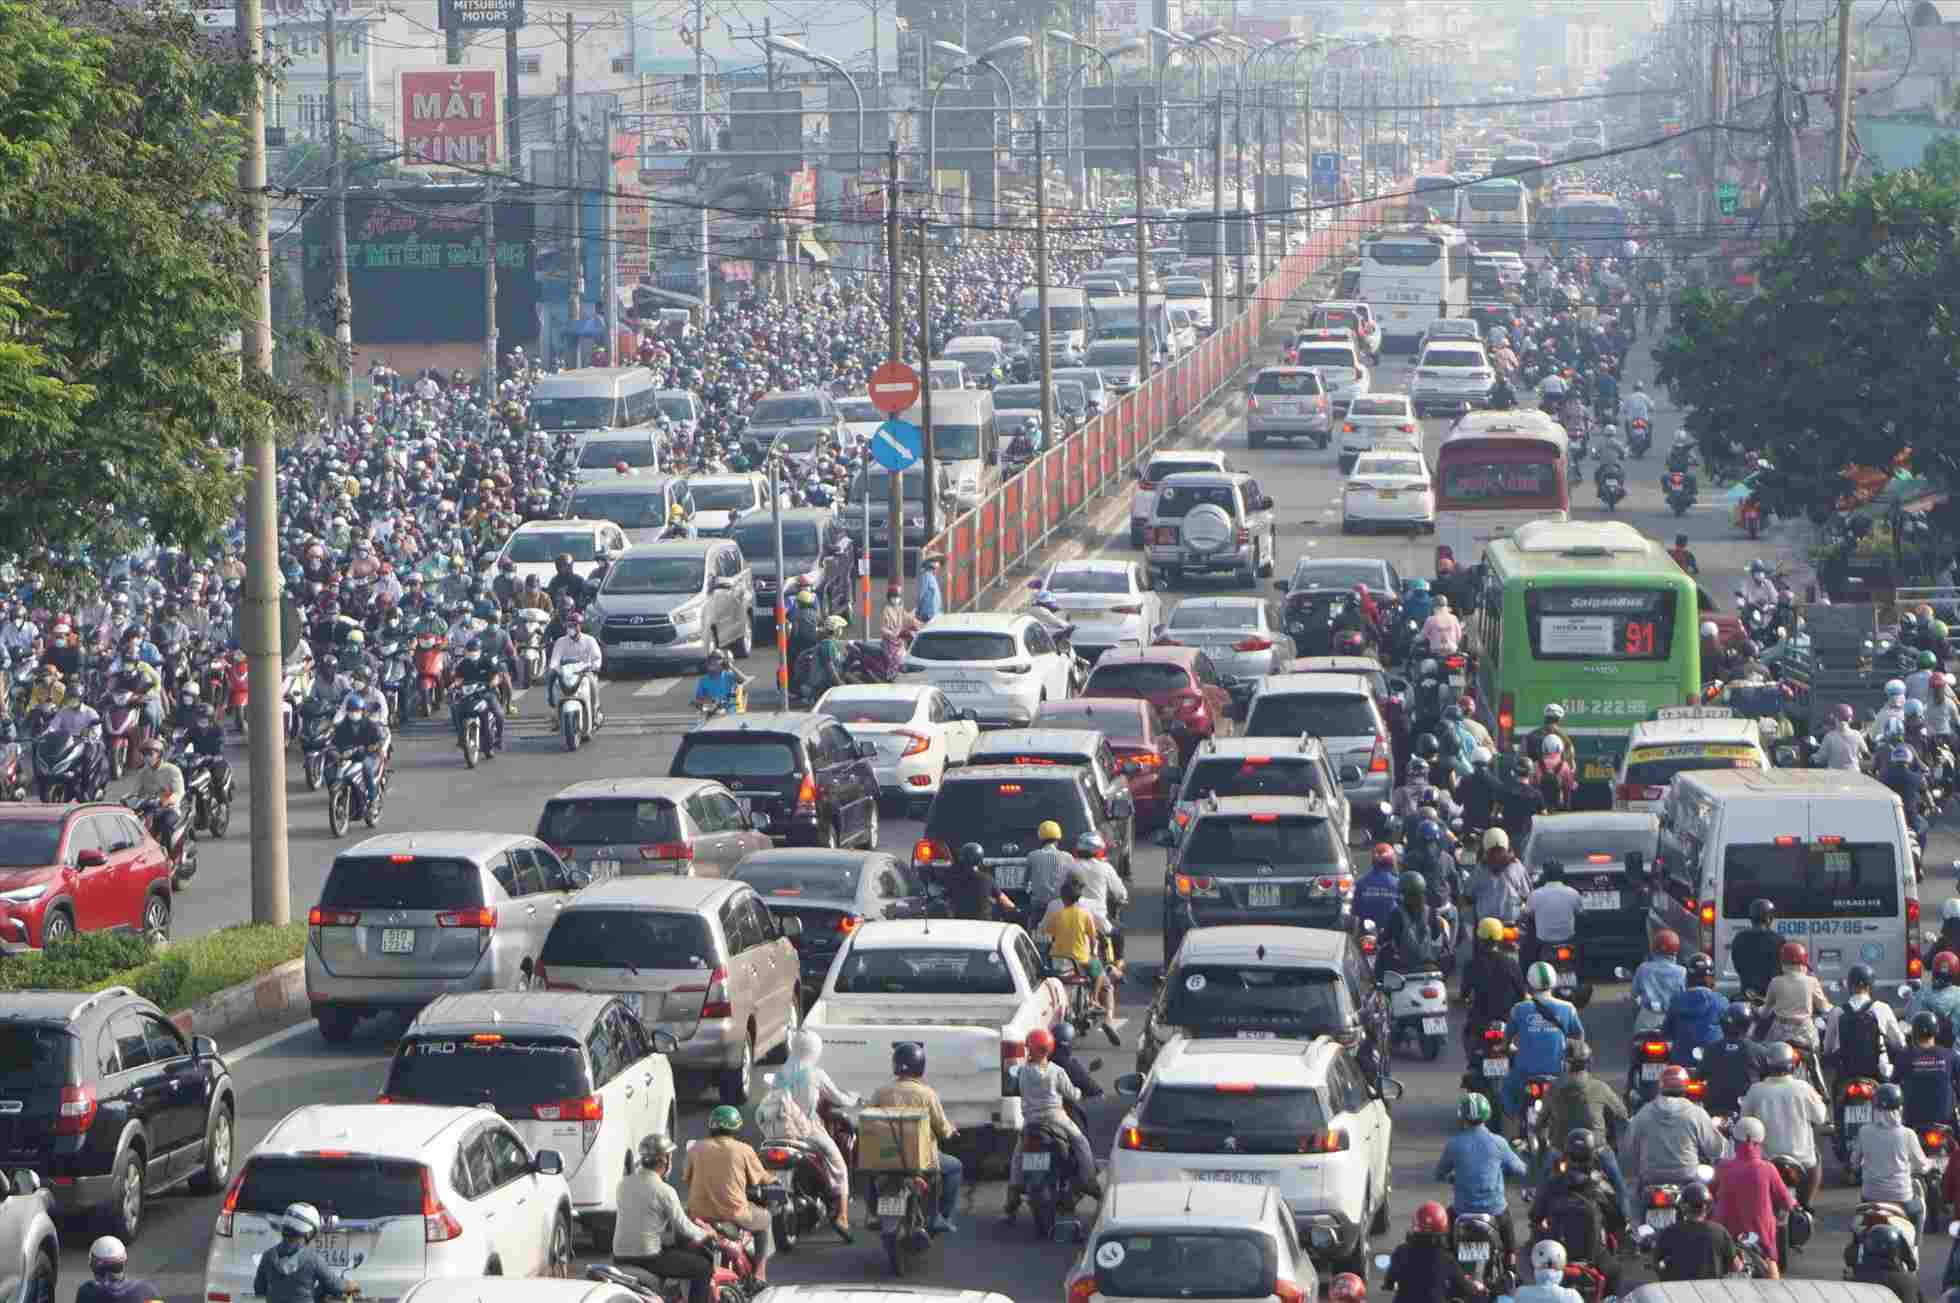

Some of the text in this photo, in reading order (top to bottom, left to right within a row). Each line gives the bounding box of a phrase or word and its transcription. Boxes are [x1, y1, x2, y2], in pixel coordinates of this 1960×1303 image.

[454, 0, 516, 10] MITSUBISHI
[462, 11, 509, 22] MOTORS
[412, 73, 487, 120] MẮT
[405, 122, 493, 163] KÍNH
[1625, 622, 1656, 656] 91
